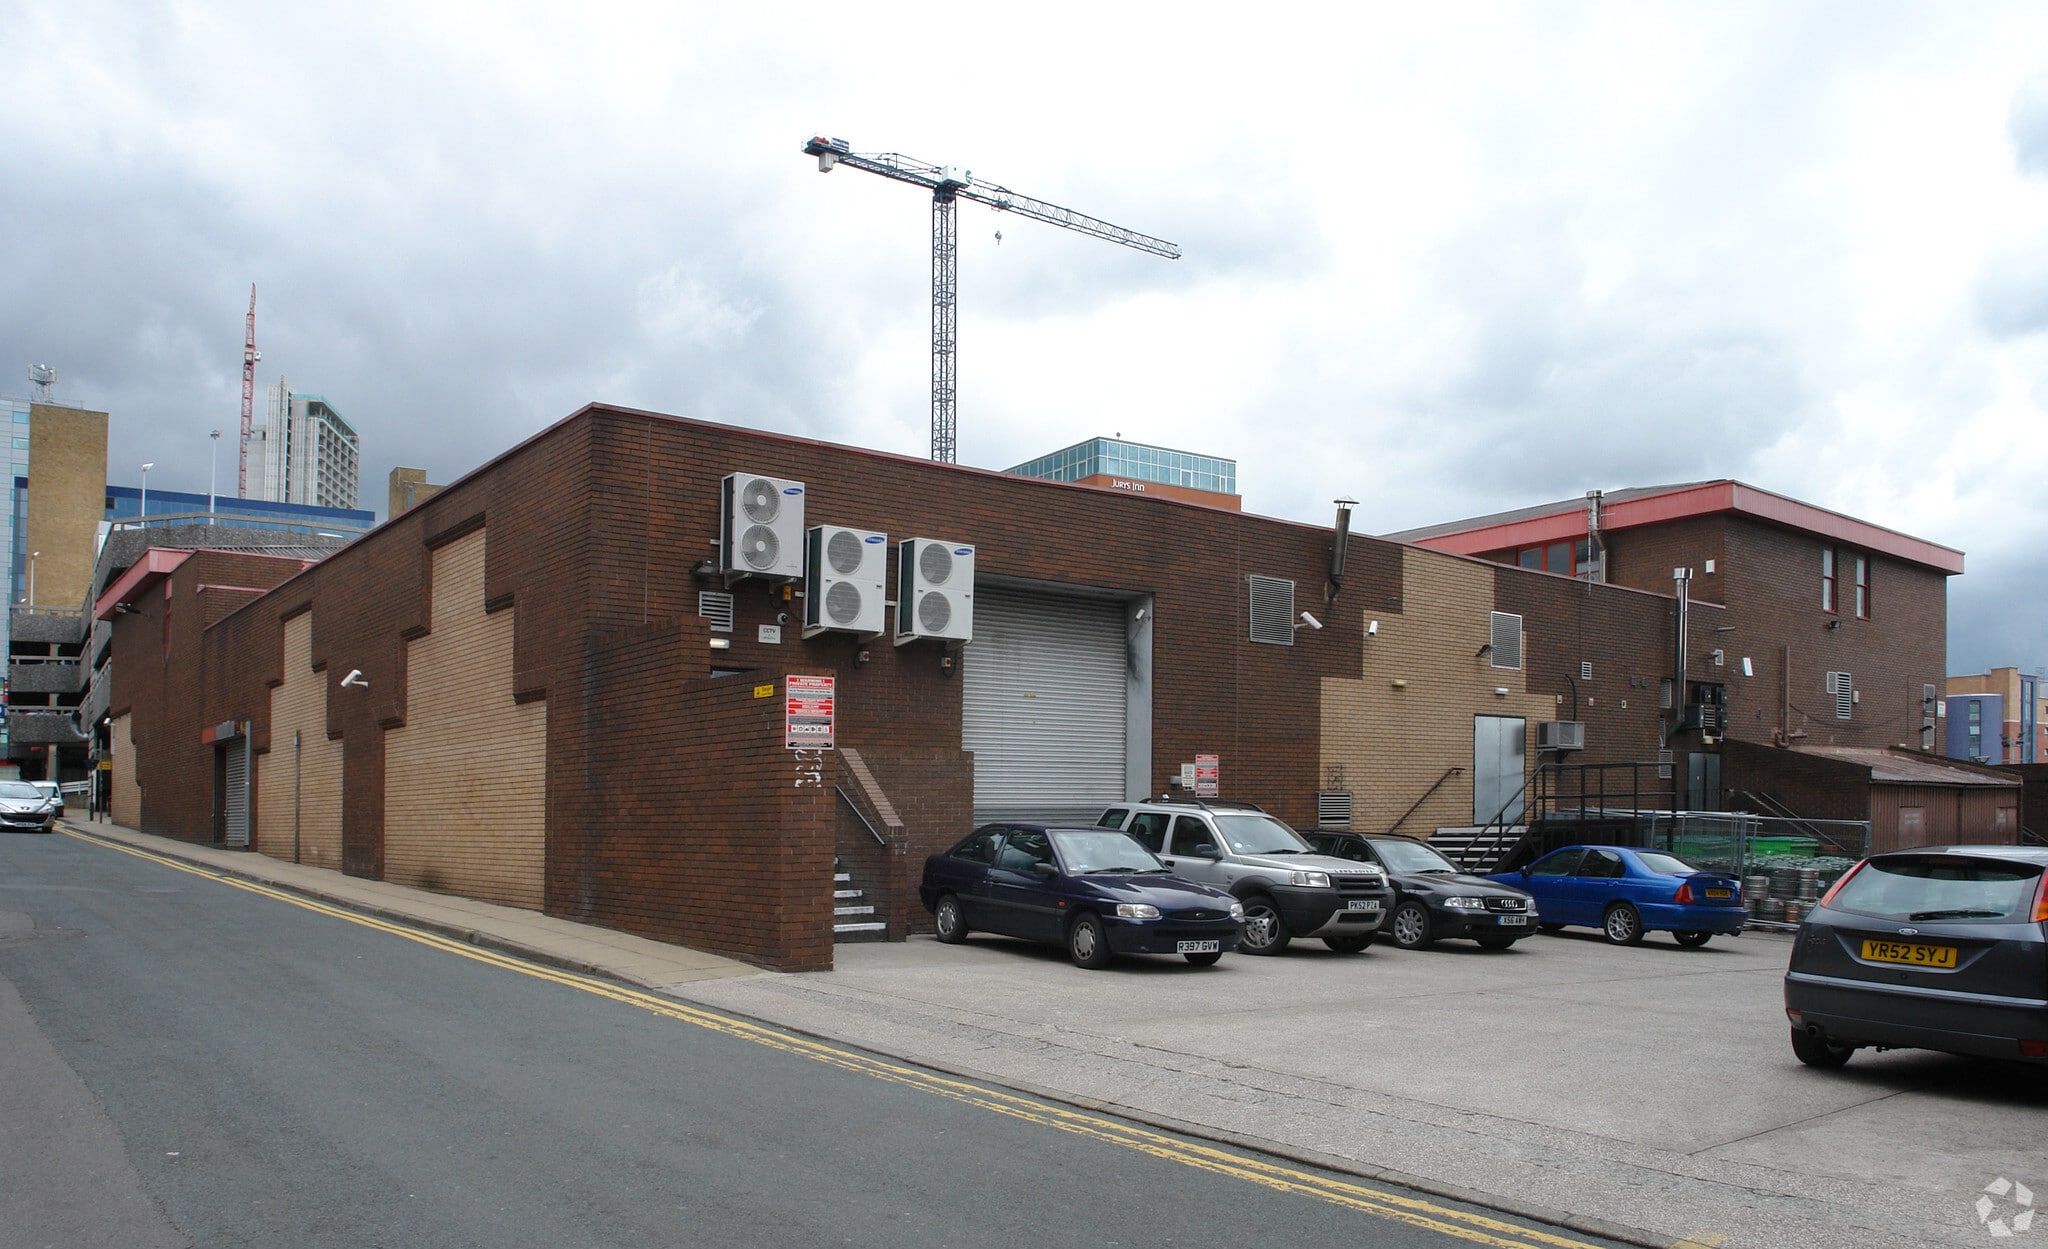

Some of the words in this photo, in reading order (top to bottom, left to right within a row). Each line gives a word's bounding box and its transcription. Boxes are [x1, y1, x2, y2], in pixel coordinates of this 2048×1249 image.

[1133, 482, 1145, 491] Inn
[1178, 942, 1200, 951] R397
[1869, 942, 1911, 960] YR52
[1915, 947, 1949, 964] SYJ
